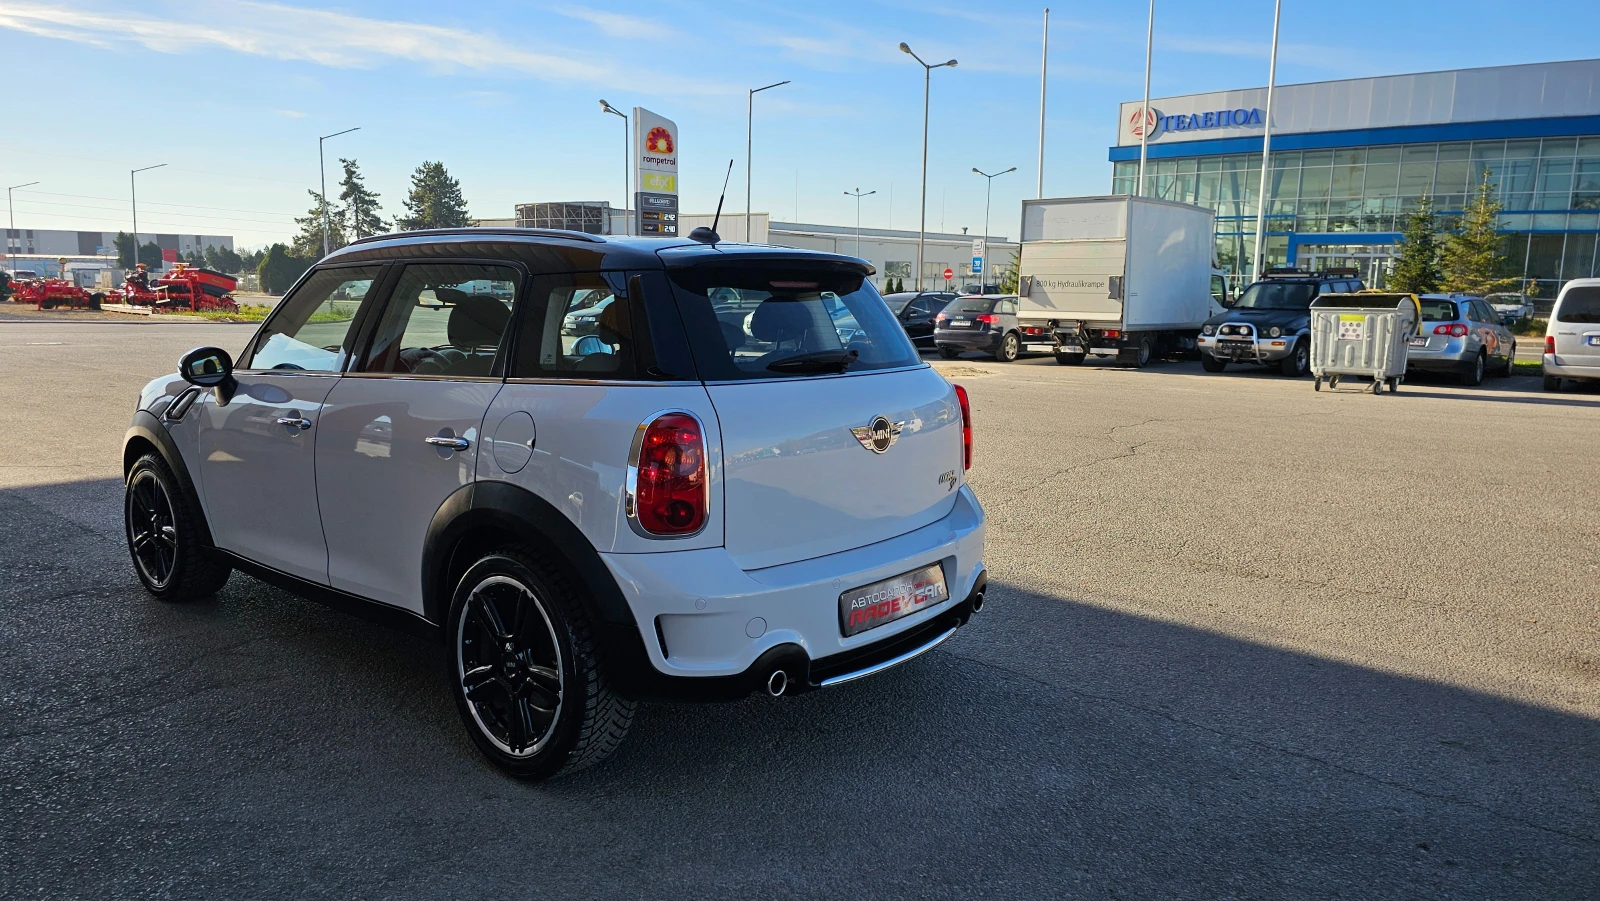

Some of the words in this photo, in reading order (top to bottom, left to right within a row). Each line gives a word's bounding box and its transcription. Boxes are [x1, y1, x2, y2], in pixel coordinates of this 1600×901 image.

[1159, 108, 1261, 132] ТЕЛЕПОЛ
[643, 156, 676, 166] rompetrol
[650, 175, 669, 189] efix
[1036, 280, 1048, 288] 800
[1048, 280, 1057, 289] kg
[1057, 280, 1105, 290] Hydraulikrampe
[873, 429, 890, 441] MINI
[851, 581, 914, 610] АВТОСАЛОН
